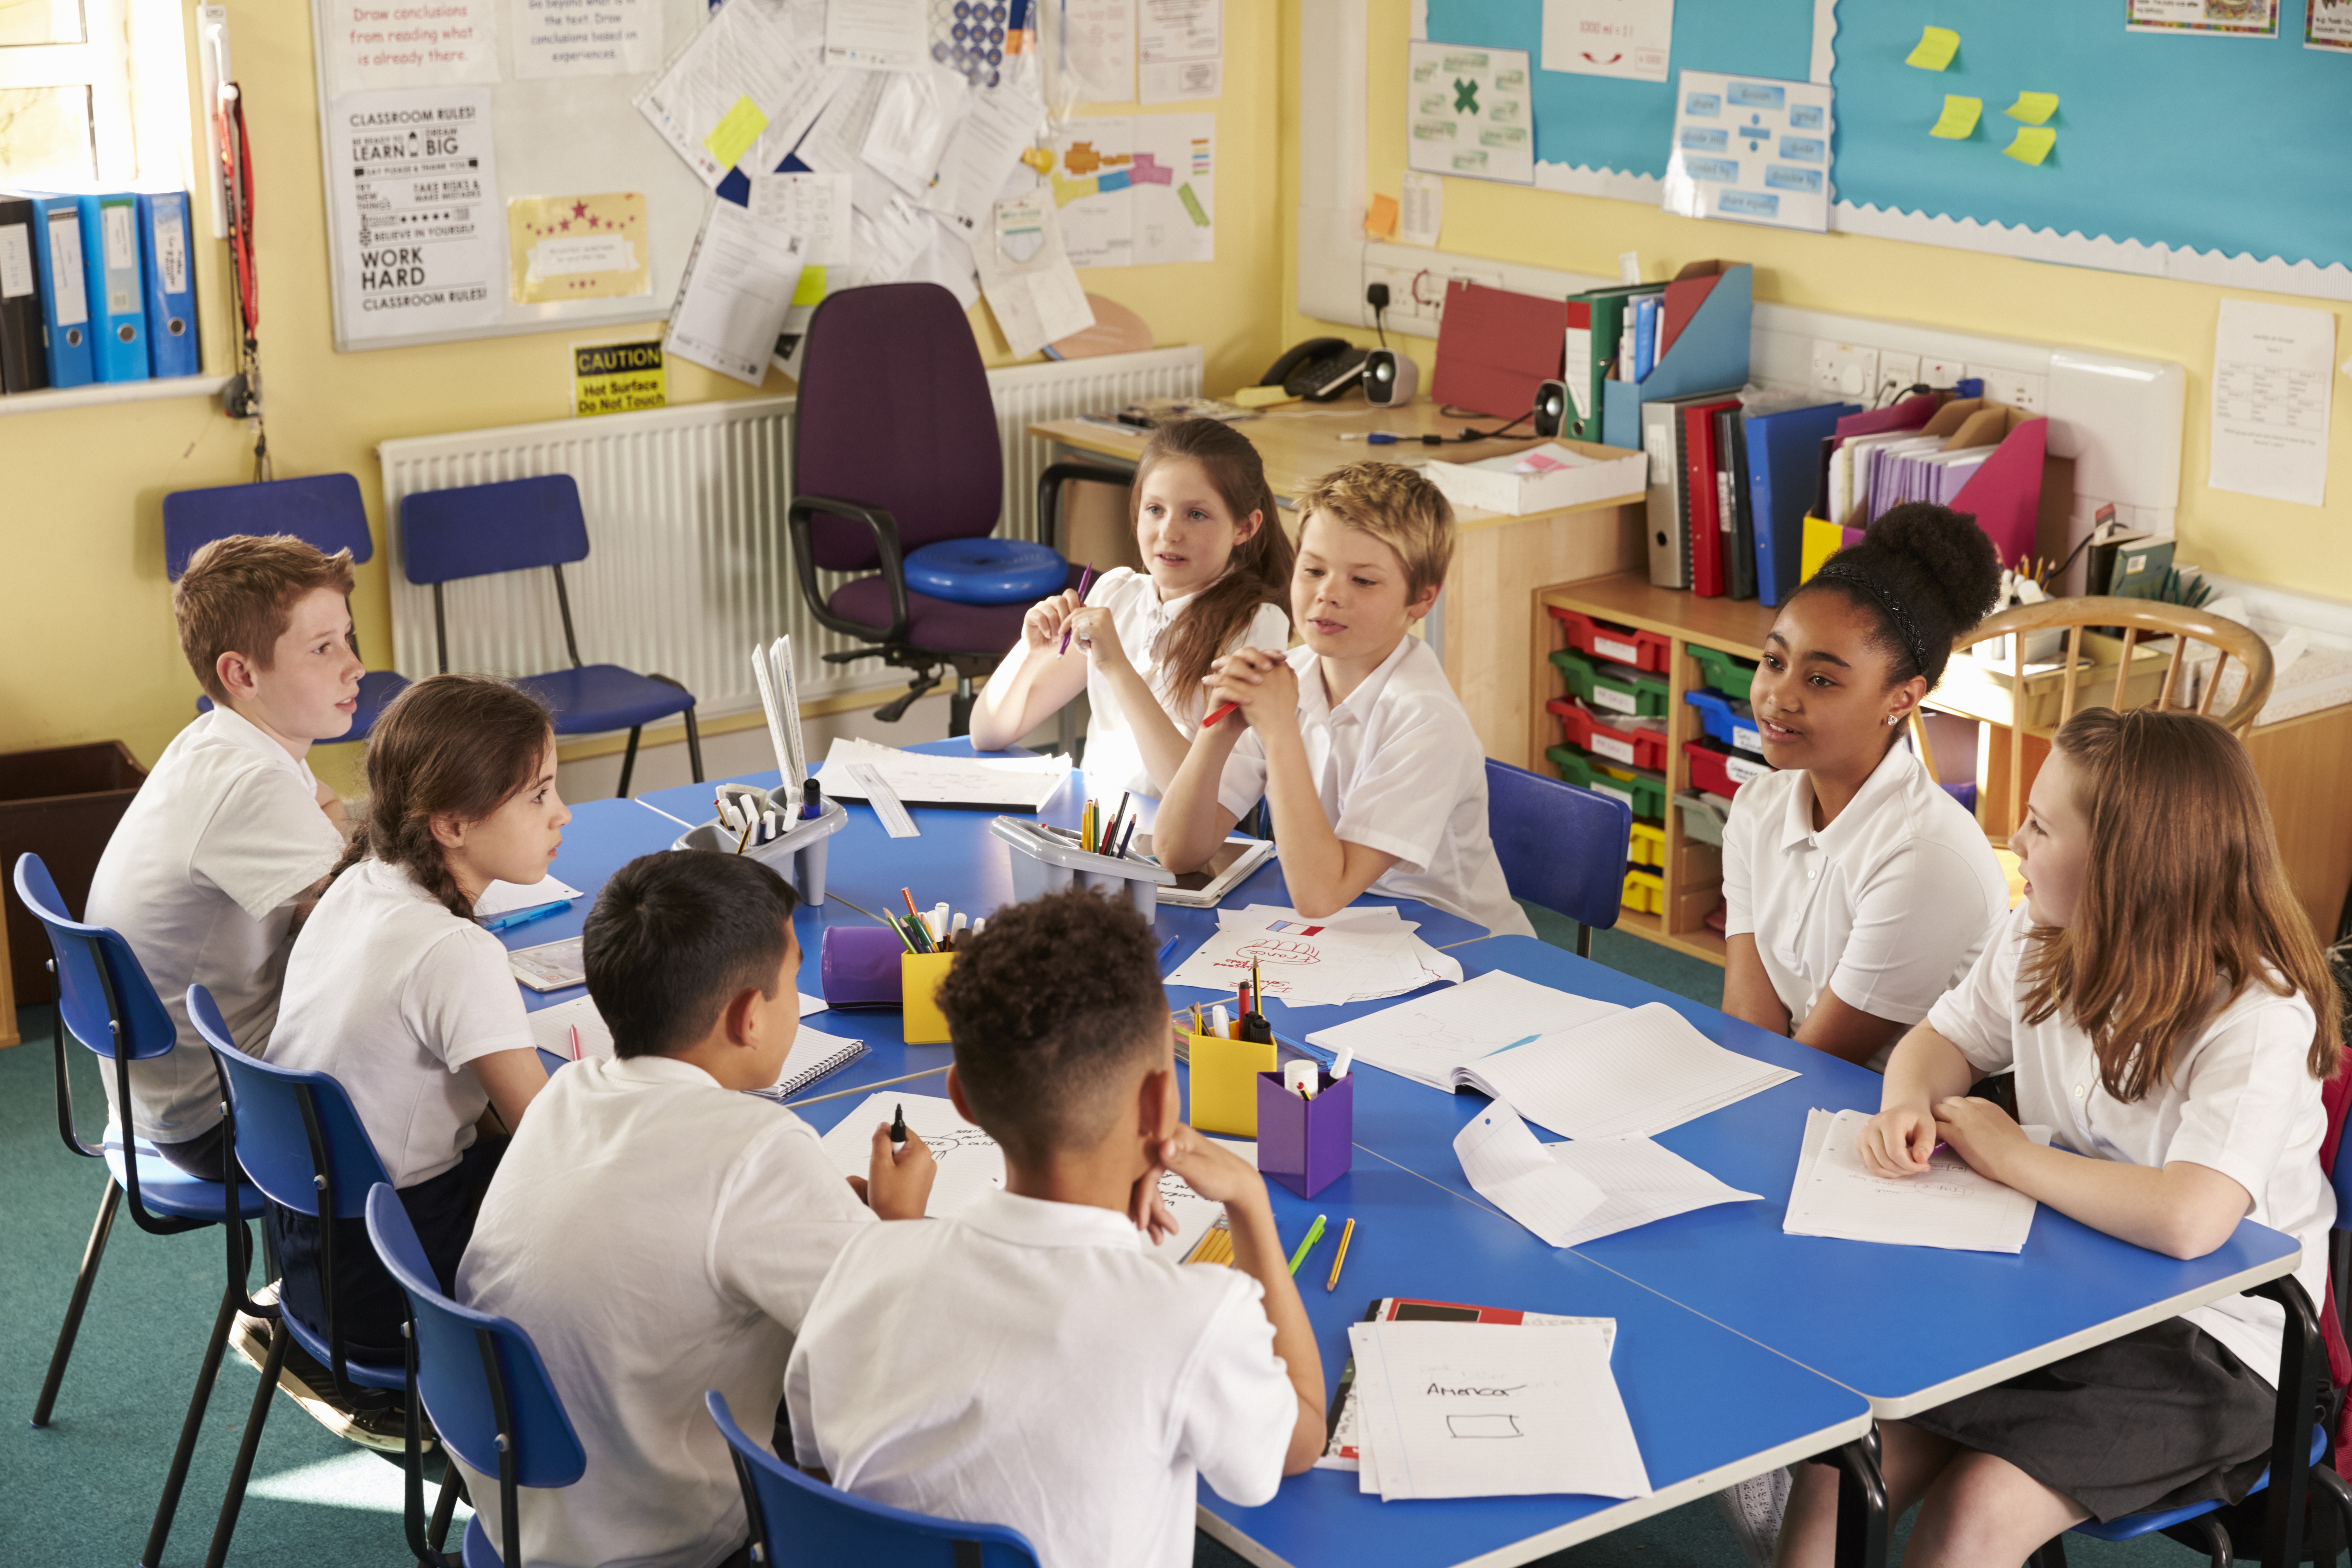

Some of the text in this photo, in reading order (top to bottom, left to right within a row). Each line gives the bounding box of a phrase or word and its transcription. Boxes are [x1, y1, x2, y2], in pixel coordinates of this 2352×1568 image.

[353, 4, 467, 22] Draw conclusions
[545, 15, 562, 26] the
[594, 13, 622, 25] Draw
[350, 25, 473, 45] from reading what
[530, 29, 638, 45] conclusions based on
[358, 52, 369, 66] is
[373, 50, 423, 67] already
[350, 106, 476, 127] CLASSROOM RULES!
[353, 144, 405, 161] LEARN
[426, 137, 459, 156] BIG
[414, 182, 439, 193] TAKE
[441, 180, 469, 191] RISKS
[374, 223, 475, 242] BELIEVE IN YOURSELF
[361, 246, 422, 268] WORK
[362, 267, 425, 290] HARD
[363, 288, 487, 312] CLASSROOM RULES!
[579, 348, 660, 372] CAUTION
[584, 379, 658, 397] Hot Surface
[579, 392, 665, 413] Do Not Touch
[1247, 950, 1311, 963] France
[1922, 1184, 1965, 1196] France
